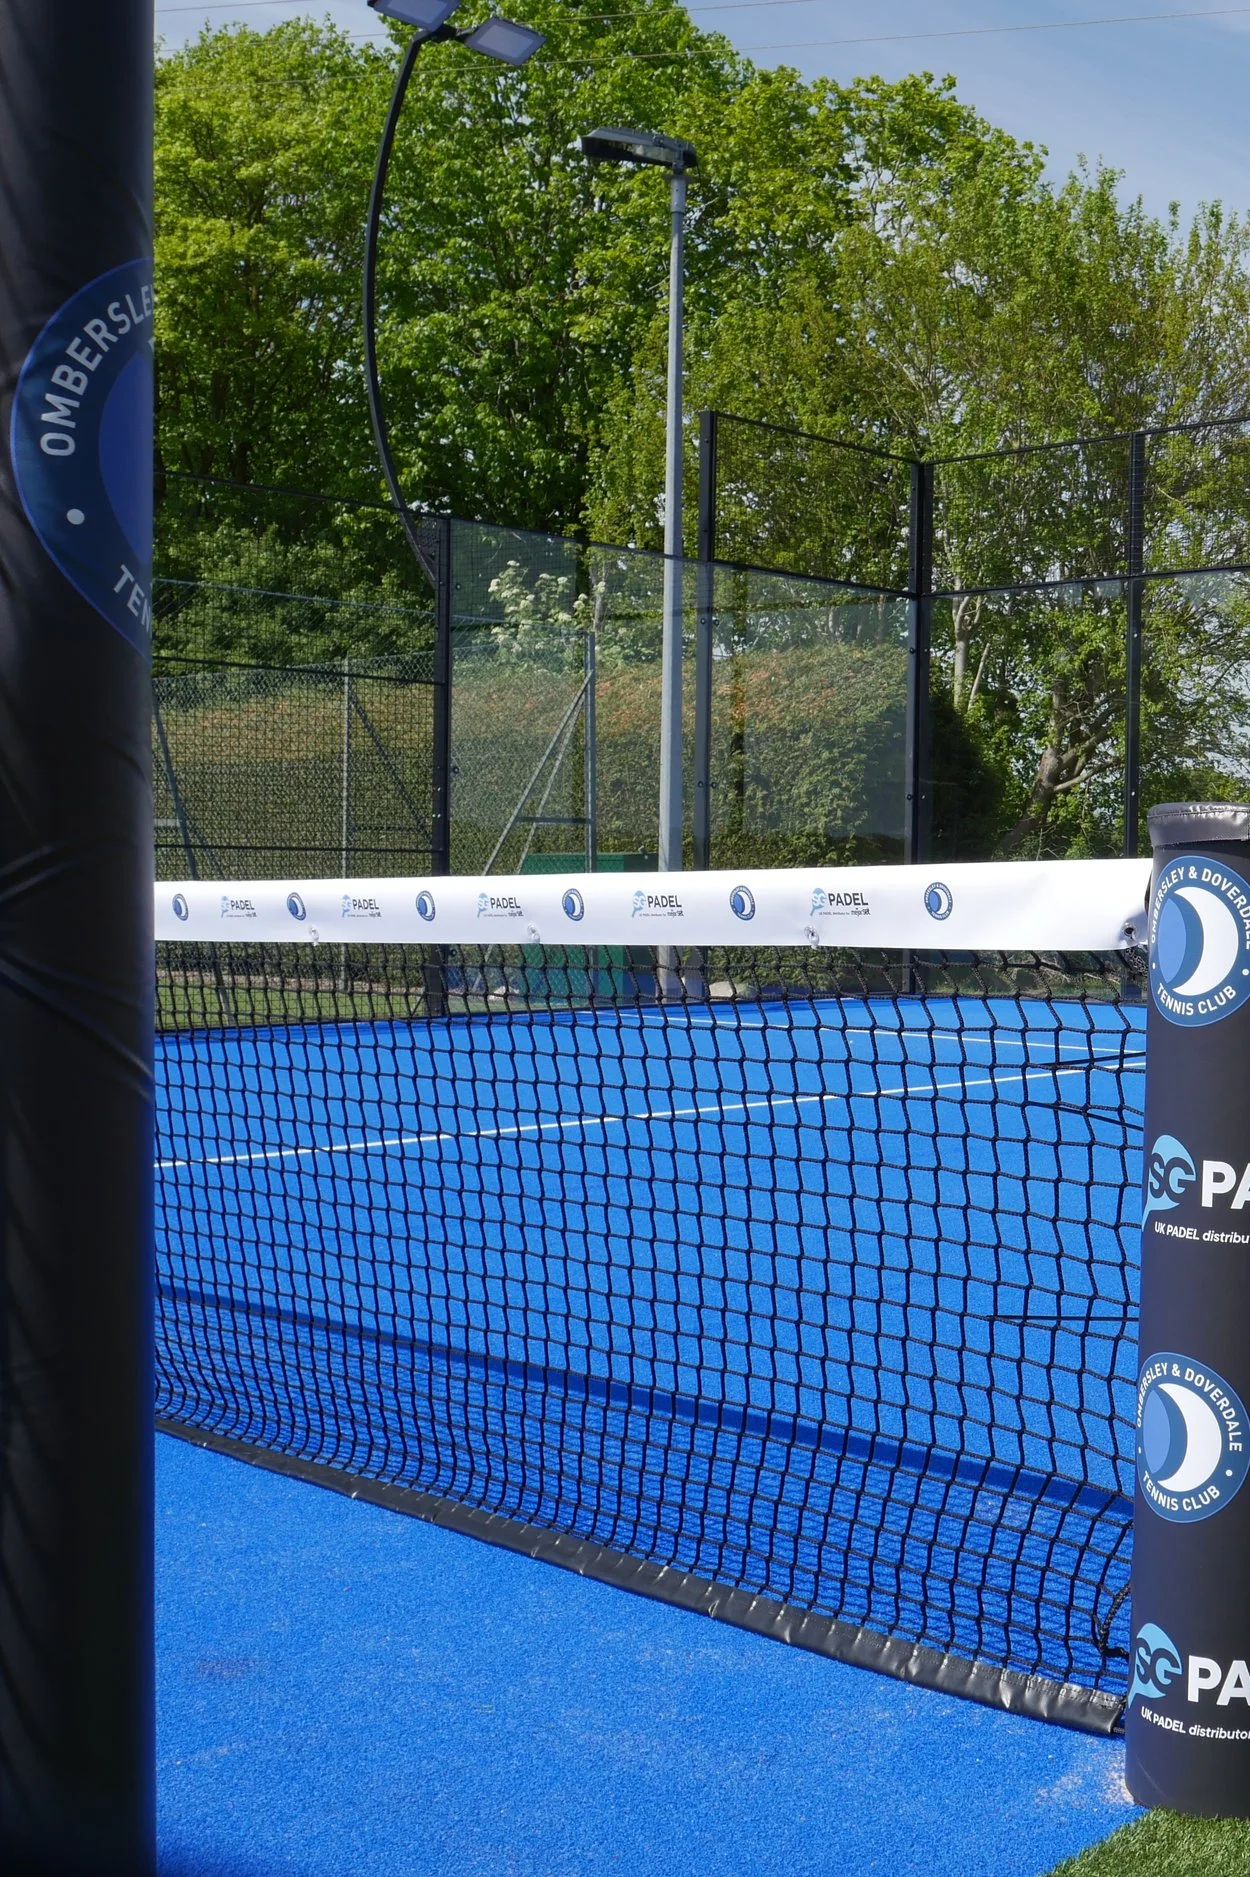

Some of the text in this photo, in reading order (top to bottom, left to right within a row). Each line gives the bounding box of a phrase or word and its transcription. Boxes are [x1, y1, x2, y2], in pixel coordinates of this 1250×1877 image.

[40, 284, 155, 457] OMBERSLE
[230, 899, 255, 911] PADEL
[352, 898, 380, 910] PADEL
[490, 897, 521, 909] PADEL
[647, 895, 682, 908] PADEL
[828, 892, 869, 906] PADEL
[1151, 866, 1185, 944] OMBERSLEY
[1188, 865, 1198, 880] &
[1156, 982, 1236, 1016] TENNIS CLUB
[1154, 1221, 1166, 1235] UK
[1166, 1224, 1200, 1241] PADEL
[1136, 1362, 1243, 1452] OMBERSLEY & DOVERDALE
[1142, 1470, 1221, 1512] TENNIS CLUB
[1141, 1706, 1152, 1722] UK
[1153, 1712, 1186, 1734] PADEL
